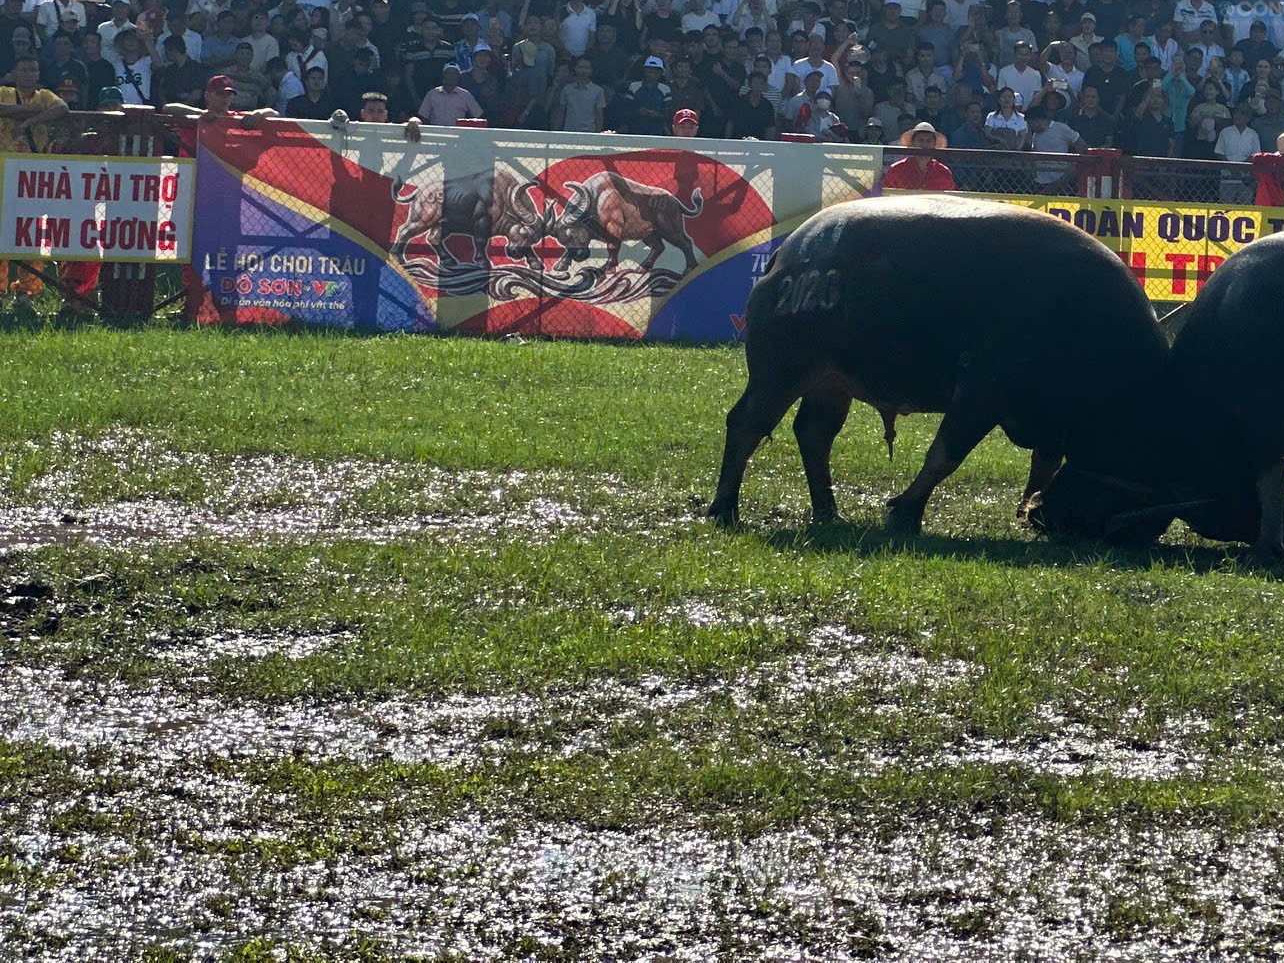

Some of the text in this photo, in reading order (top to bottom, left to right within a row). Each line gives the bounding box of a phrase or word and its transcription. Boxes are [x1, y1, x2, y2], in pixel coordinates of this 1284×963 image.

[17, 165, 180, 209] NHÀ TÀI TRỢ
[15, 216, 177, 251] KIM CƯƠNG
[1157, 209, 1256, 244] QUỐC
[233, 250, 265, 274] HỘI
